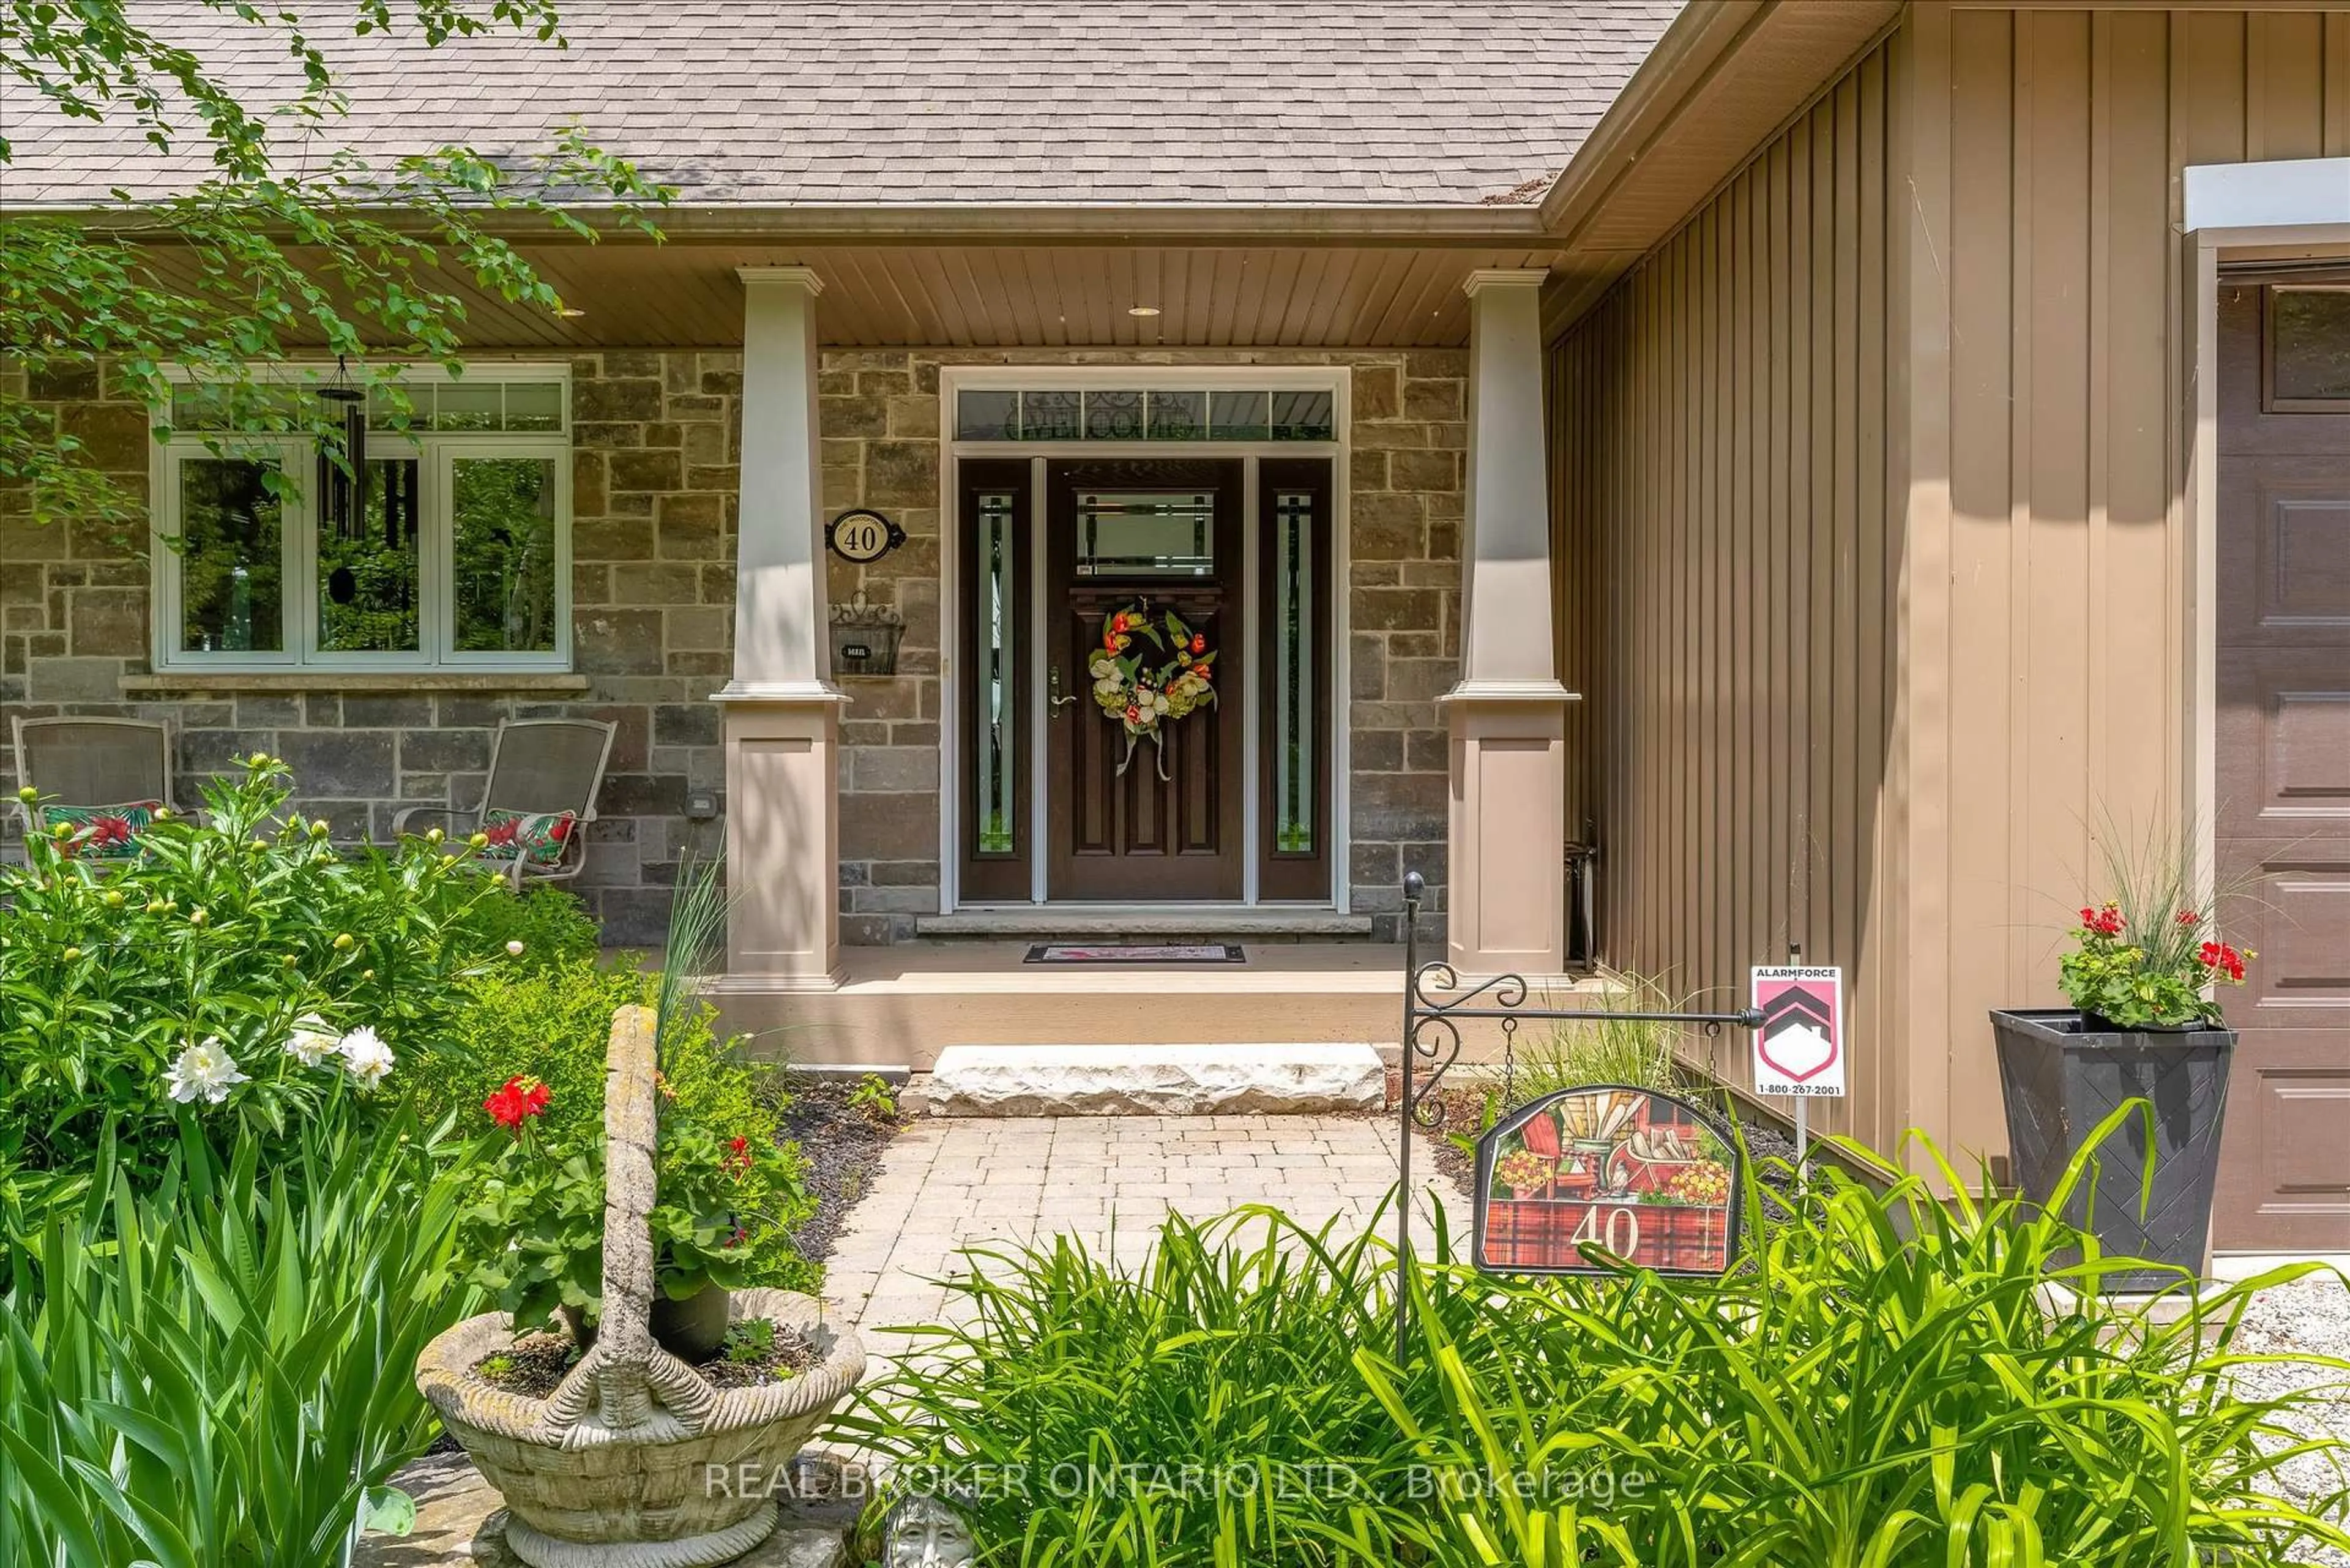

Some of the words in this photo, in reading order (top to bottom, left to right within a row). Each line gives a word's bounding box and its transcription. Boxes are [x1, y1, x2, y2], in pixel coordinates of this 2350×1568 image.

[844, 526, 876, 551] 40
[1756, 969, 1836, 977] ALARMFORCE
[1759, 1084, 1840, 1095] 1-800-267-2001
[1570, 1205, 1639, 1260] 40
